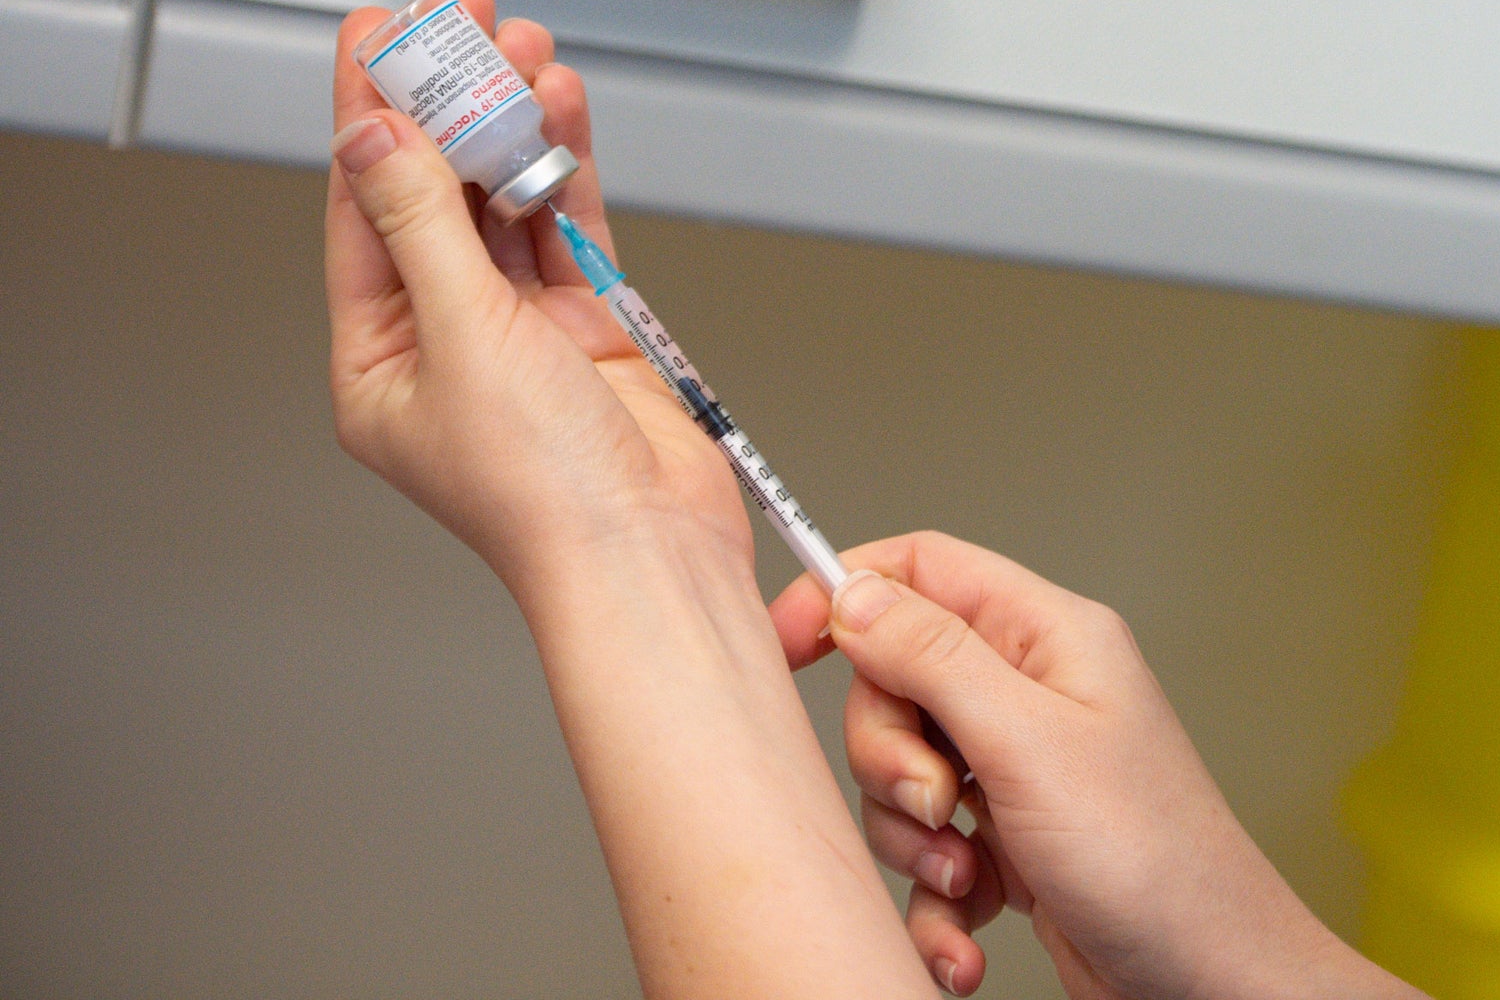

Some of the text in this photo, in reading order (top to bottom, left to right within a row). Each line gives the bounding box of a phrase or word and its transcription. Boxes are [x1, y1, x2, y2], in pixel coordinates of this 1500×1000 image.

[428, 14, 446, 30] doses
[408, 32, 421, 44] 0.5
[420, 26, 428, 35] of
[395, 41, 410, 55] mL)
[422, 35, 436, 47] vial
[409, 49, 497, 118] COVID-19 mRNA Vaccine
[410, 67, 449, 101] modified)
[445, 77, 476, 105] Dispersion
[472, 69, 512, 98] Moderna
[436, 102, 446, 111] for
[436, 79, 521, 146] COVID-19 Vaccine
